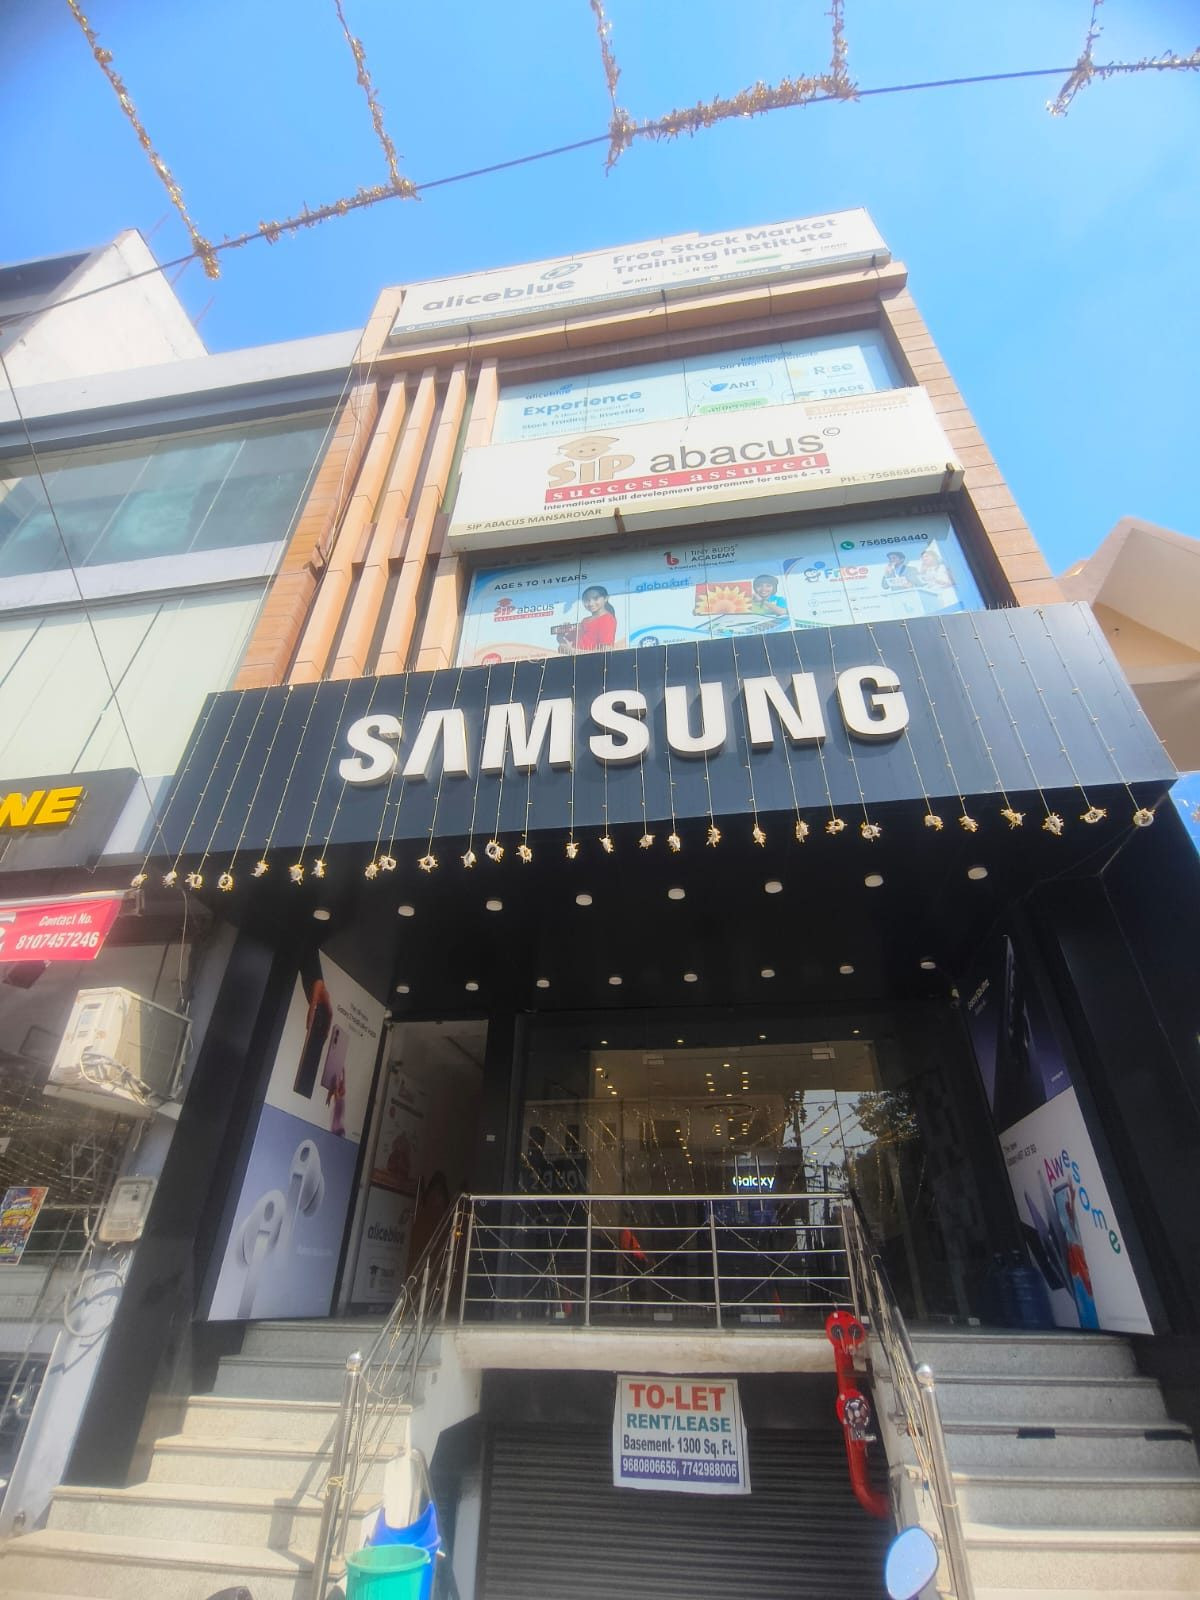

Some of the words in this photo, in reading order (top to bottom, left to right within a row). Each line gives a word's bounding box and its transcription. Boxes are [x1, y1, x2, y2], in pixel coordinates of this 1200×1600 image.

[613, 249, 664, 265] Free
[671, 235, 739, 255] Stock
[746, 219, 838, 242] Market
[613, 250, 718, 275] Training
[724, 231, 833, 256] Institute
[422, 279, 576, 312] aliceblue
[728, 379, 757, 391] ANT
[523, 390, 642, 416] Experience
[650, 434, 824, 473] abacus
[552, 477, 669, 500] success
[690, 456, 818, 482] assured
[544, 497, 606, 511] International
[608, 494, 628, 503] skill
[630, 487, 694, 501] development
[696, 478, 755, 493] programme
[757, 475, 773, 483] for
[774, 472, 799, 482] ages
[466, 522, 482, 531] SIP
[484, 517, 525, 529] ABACUS
[527, 508, 603, 524] MANSAROVAR
[859, 533, 929, 547] 7568684440
[691, 547, 710, 556] TINY
[691, 551, 736, 562] ACADEMY
[494, 582, 515, 591] AGE
[555, 573, 588, 583] YEARS
[517, 603, 554, 614] abacus
[338, 665, 911, 785] SAMSUNG
[38, 913, 75, 927] Contact
[78, 912, 93, 924] No.
[16, 932, 100, 950] 8107457246
[732, 1174, 775, 1190] Galaxy
[1043, 1149, 1121, 1254] Awesome
[628, 1383, 726, 1412] TO-LET
[626, 1412, 732, 1432] RENT/LEASE
[677, 1437, 701, 1454] 1300
[704, 1438, 720, 1459] Sq.
[722, 1439, 736, 1456] Ft.
[681, 1461, 737, 1478] 7742988006
